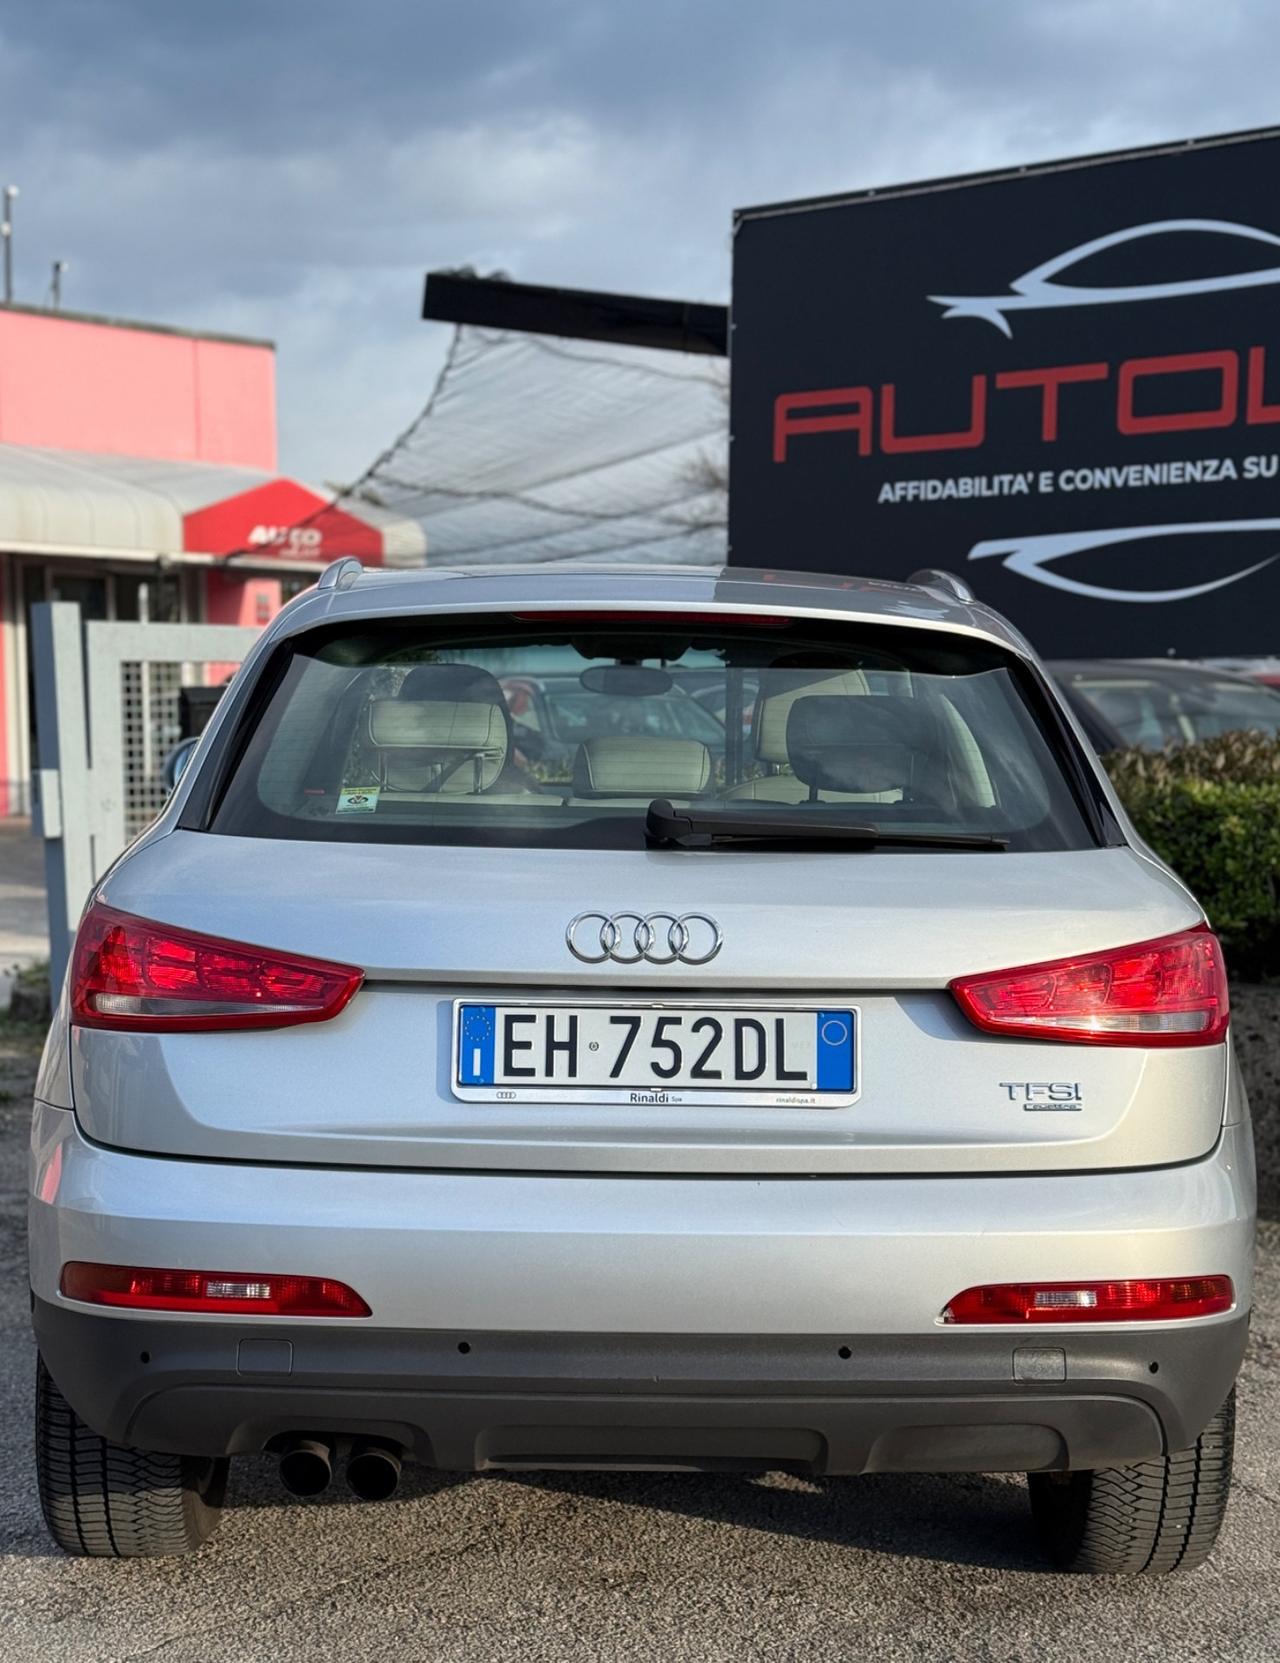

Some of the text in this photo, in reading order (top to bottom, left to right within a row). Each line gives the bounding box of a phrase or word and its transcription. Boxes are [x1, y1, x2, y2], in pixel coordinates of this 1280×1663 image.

[877, 455, 1279, 504] AFFIDABILITA' E CONVENIENZA SU
[503, 1014, 579, 1078] EH
[609, 1015, 808, 1081] 752DL
[630, 1092, 669, 1103] Rinaldi
[998, 1082, 1083, 1101] TFSI
